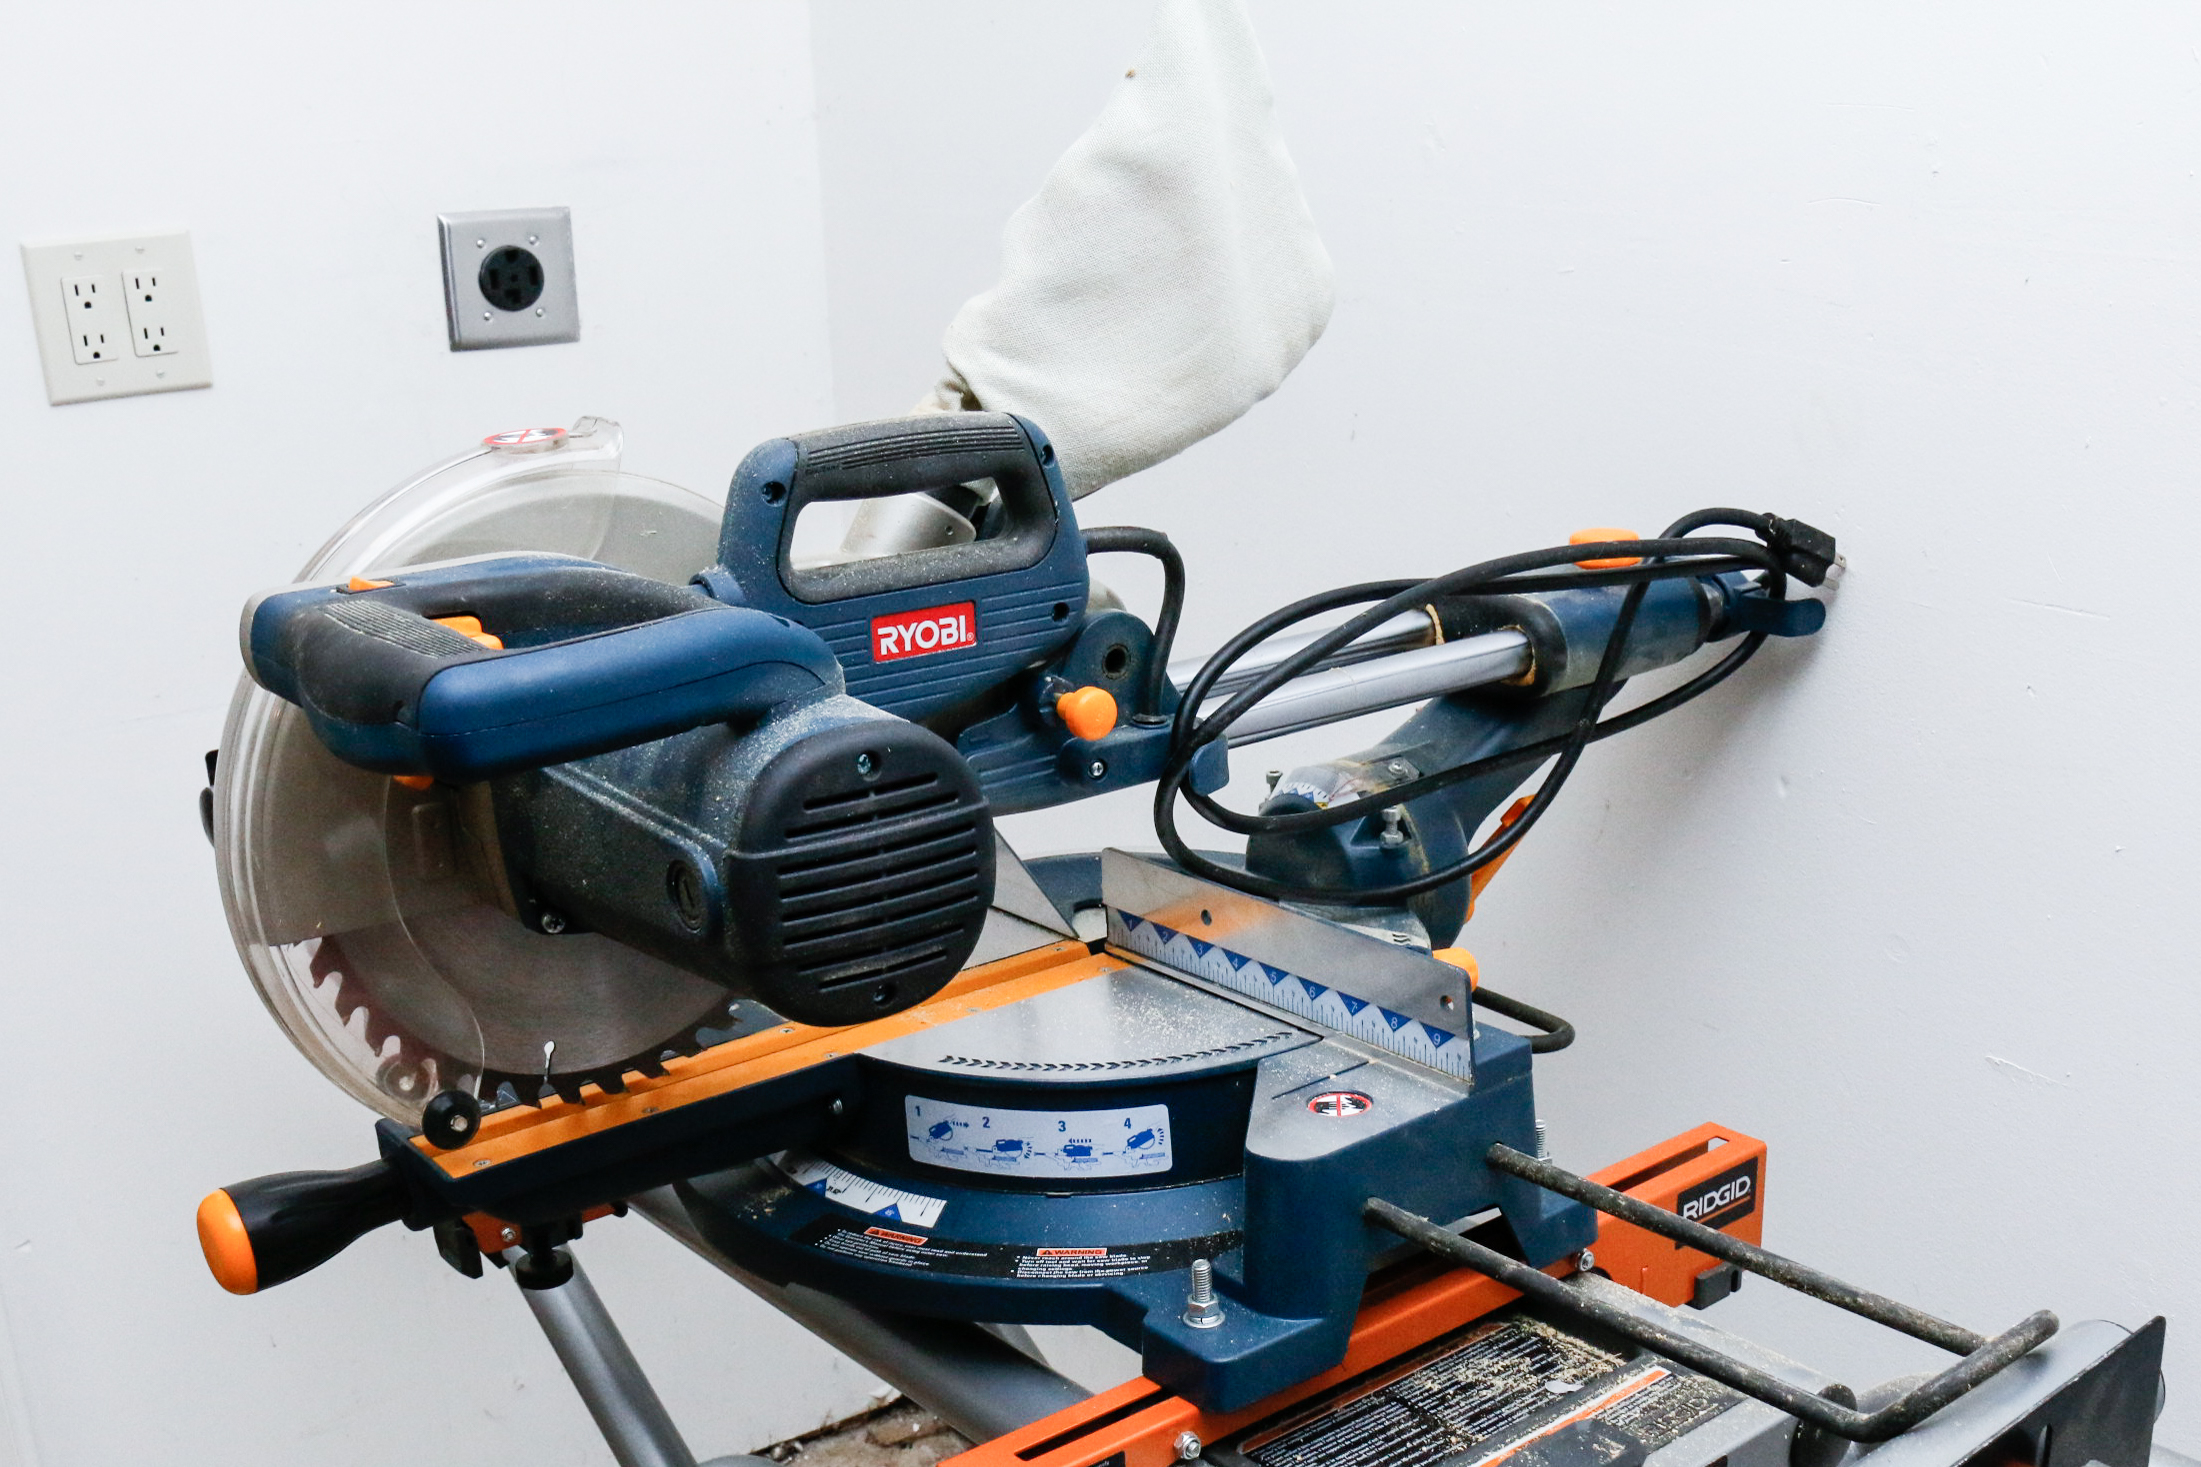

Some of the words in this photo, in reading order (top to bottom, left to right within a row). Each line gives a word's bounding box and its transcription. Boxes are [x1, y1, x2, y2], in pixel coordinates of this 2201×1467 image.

[1162, 931, 1168, 943] 2
[1197, 944, 1203, 955] 3
[1232, 958, 1239, 968] 4
[1270, 972, 1277, 983] 5
[1309, 986, 1316, 998] 6
[1351, 1001, 1358, 1013] 7
[1390, 1017, 1398, 1029] 8
[1433, 1033, 1441, 1045] 9
[915, 1106, 921, 1117] 1
[982, 1116, 991, 1128] 2
[1058, 1120, 1067, 1132] 3
[1123, 1117, 1132, 1129] 4
[1683, 1175, 1751, 1219] RIDGID
